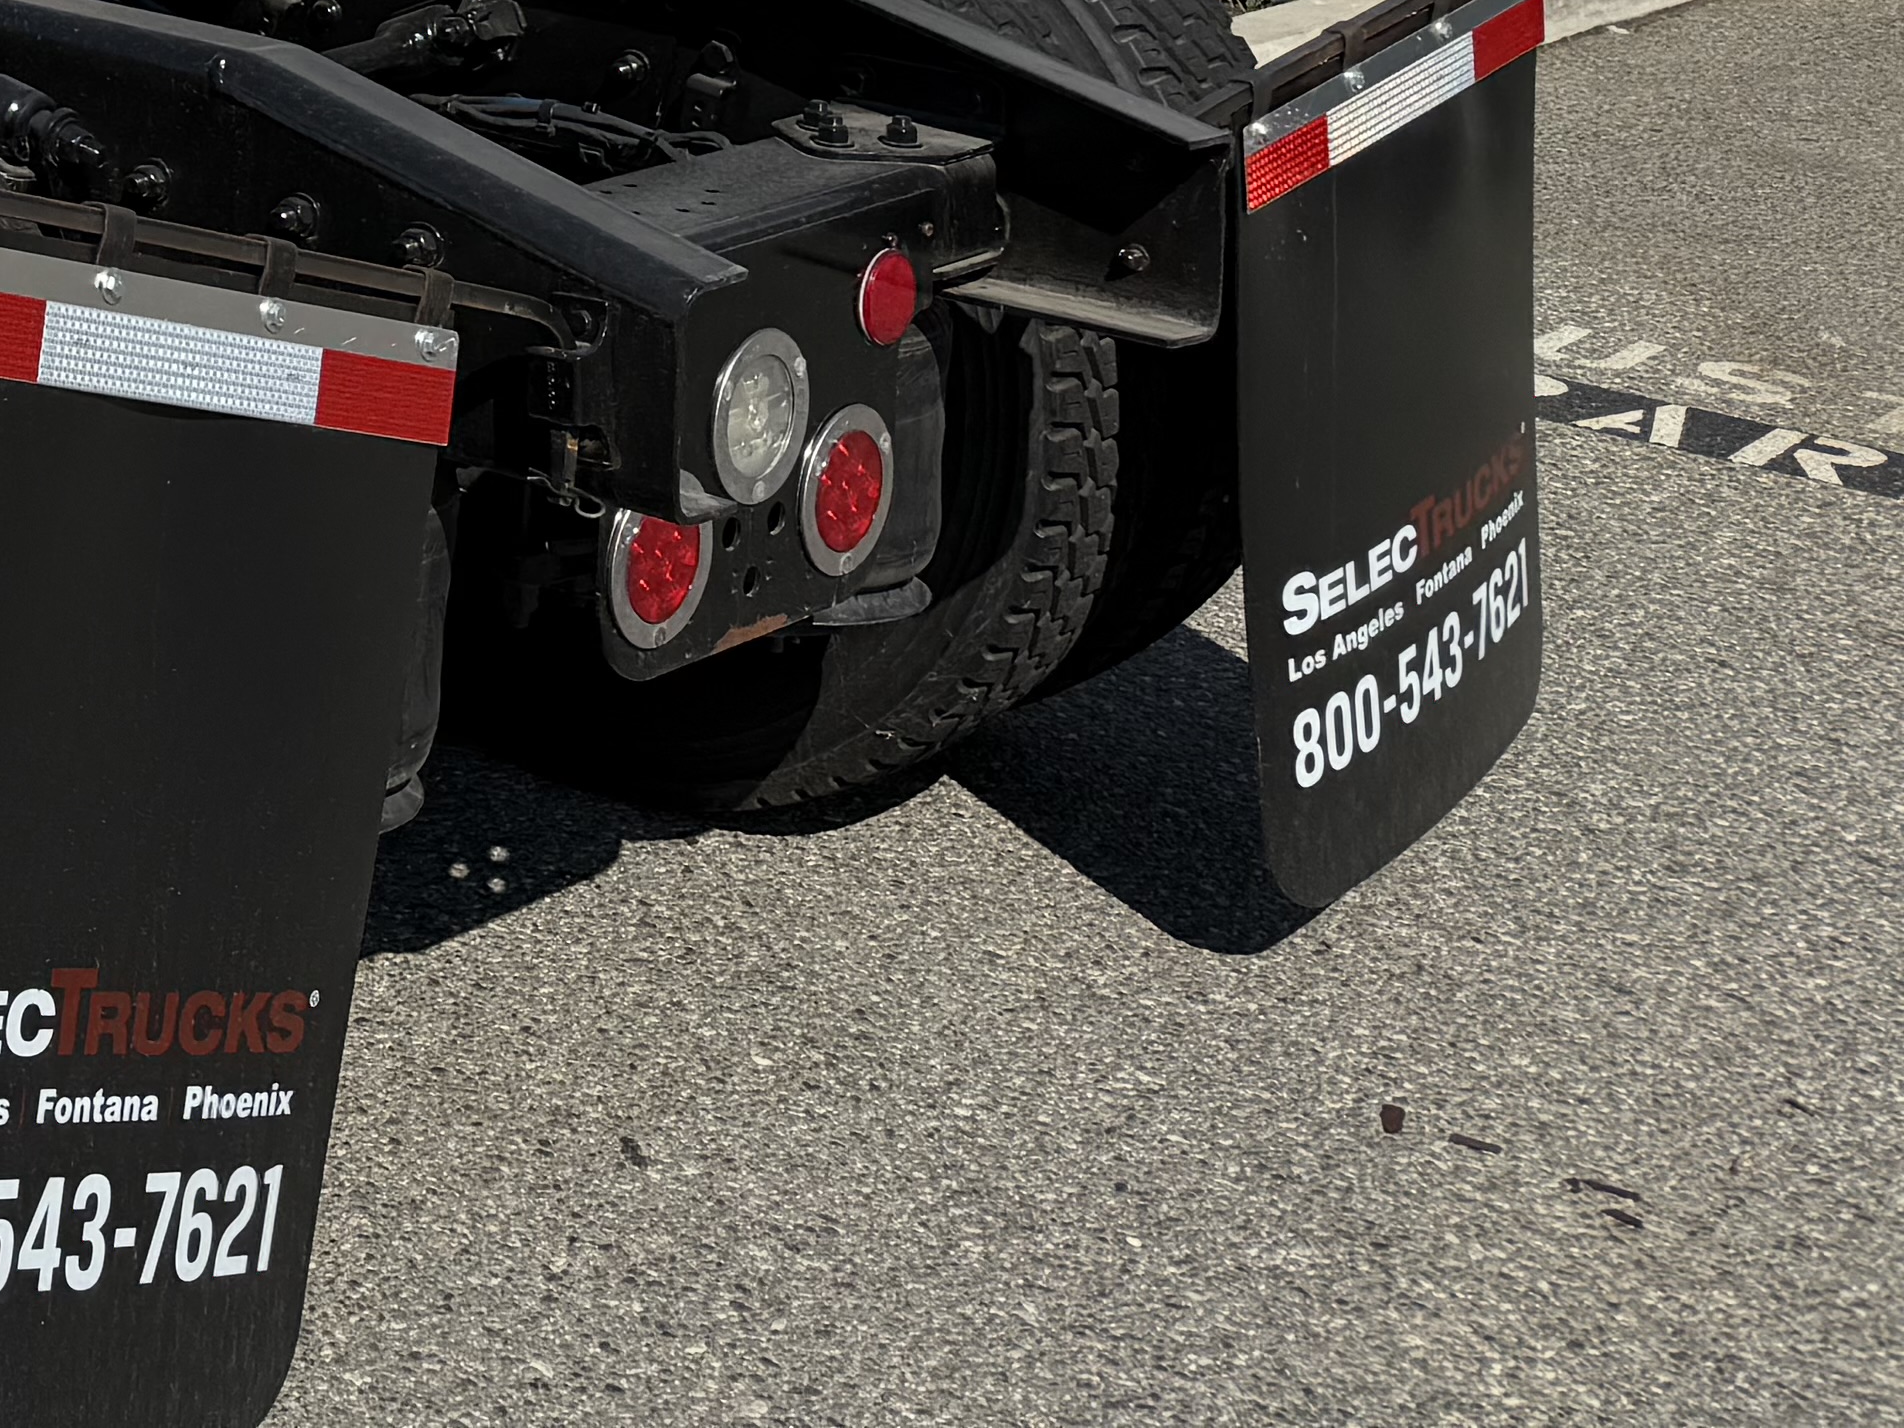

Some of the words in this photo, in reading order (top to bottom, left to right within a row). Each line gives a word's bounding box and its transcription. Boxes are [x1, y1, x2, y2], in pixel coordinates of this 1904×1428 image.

[1288, 646, 1327, 683] Los
[1332, 599, 1404, 660] Angeles
[1416, 545, 1473, 605] Fontana
[1481, 489, 1524, 549] Phoenix
[1293, 537, 1529, 788] 800-543-7621
[36, 1087, 158, 1124] Fontana
[182, 1083, 293, 1120] Phoenix
